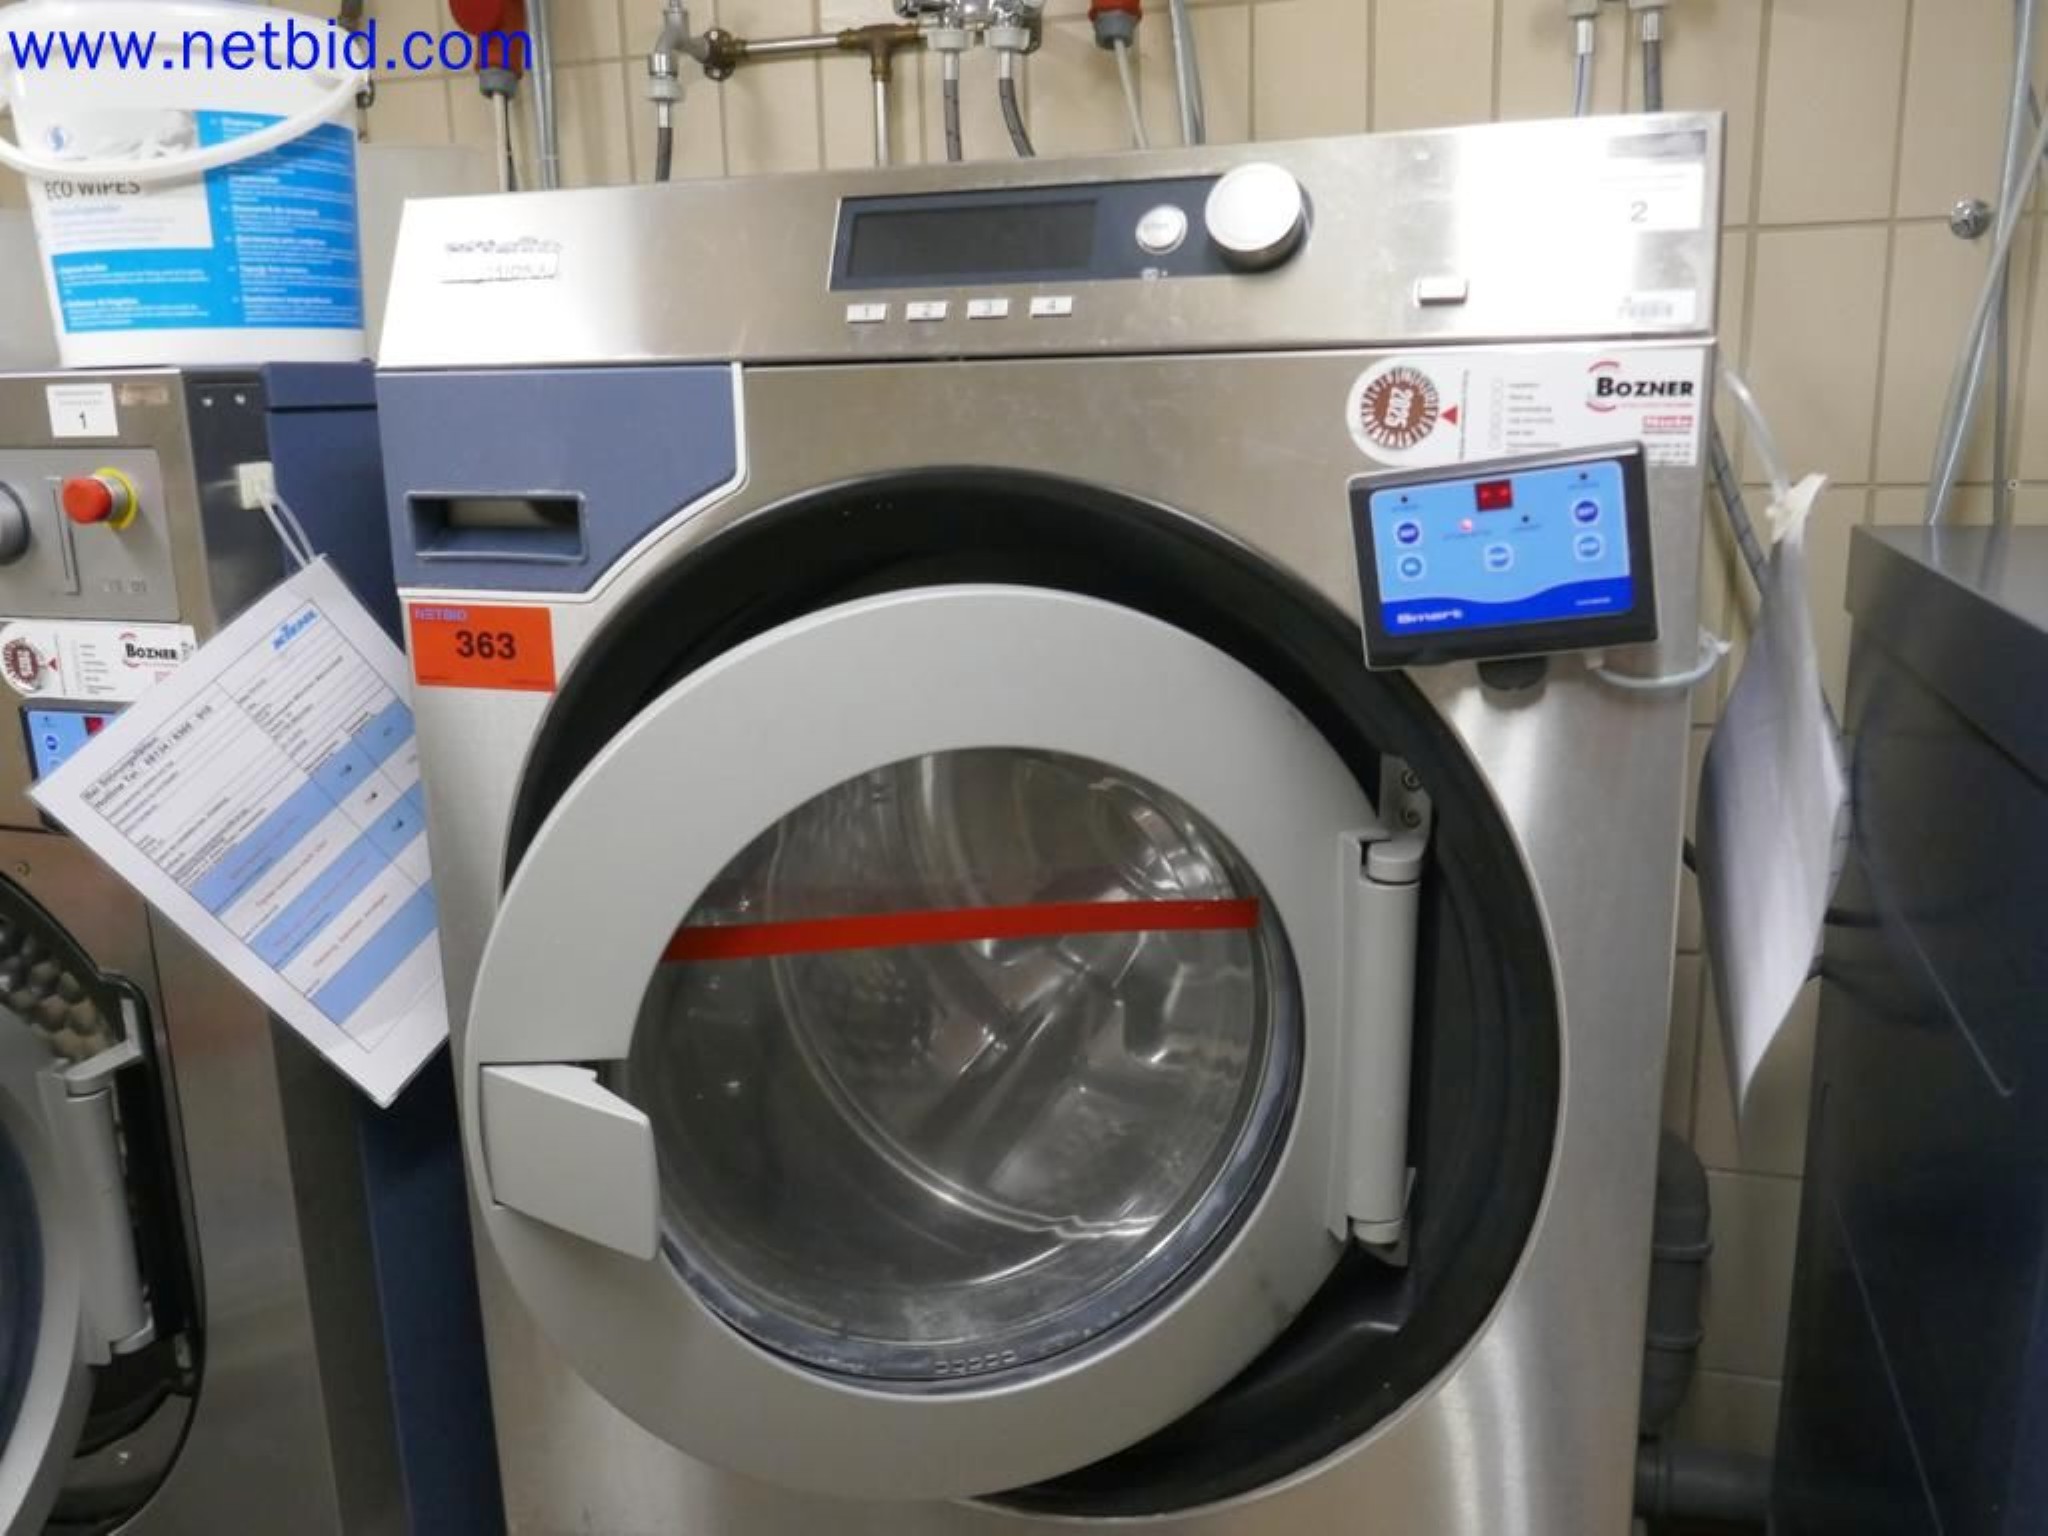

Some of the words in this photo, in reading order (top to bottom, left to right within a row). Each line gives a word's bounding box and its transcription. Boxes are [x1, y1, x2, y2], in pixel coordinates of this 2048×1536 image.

[45, 179, 73, 201] ECO
[77, 179, 141, 197] WIPES
[1631, 200, 1649, 223] 2
[78, 410, 87, 430] 1
[455, 630, 517, 660] 363
